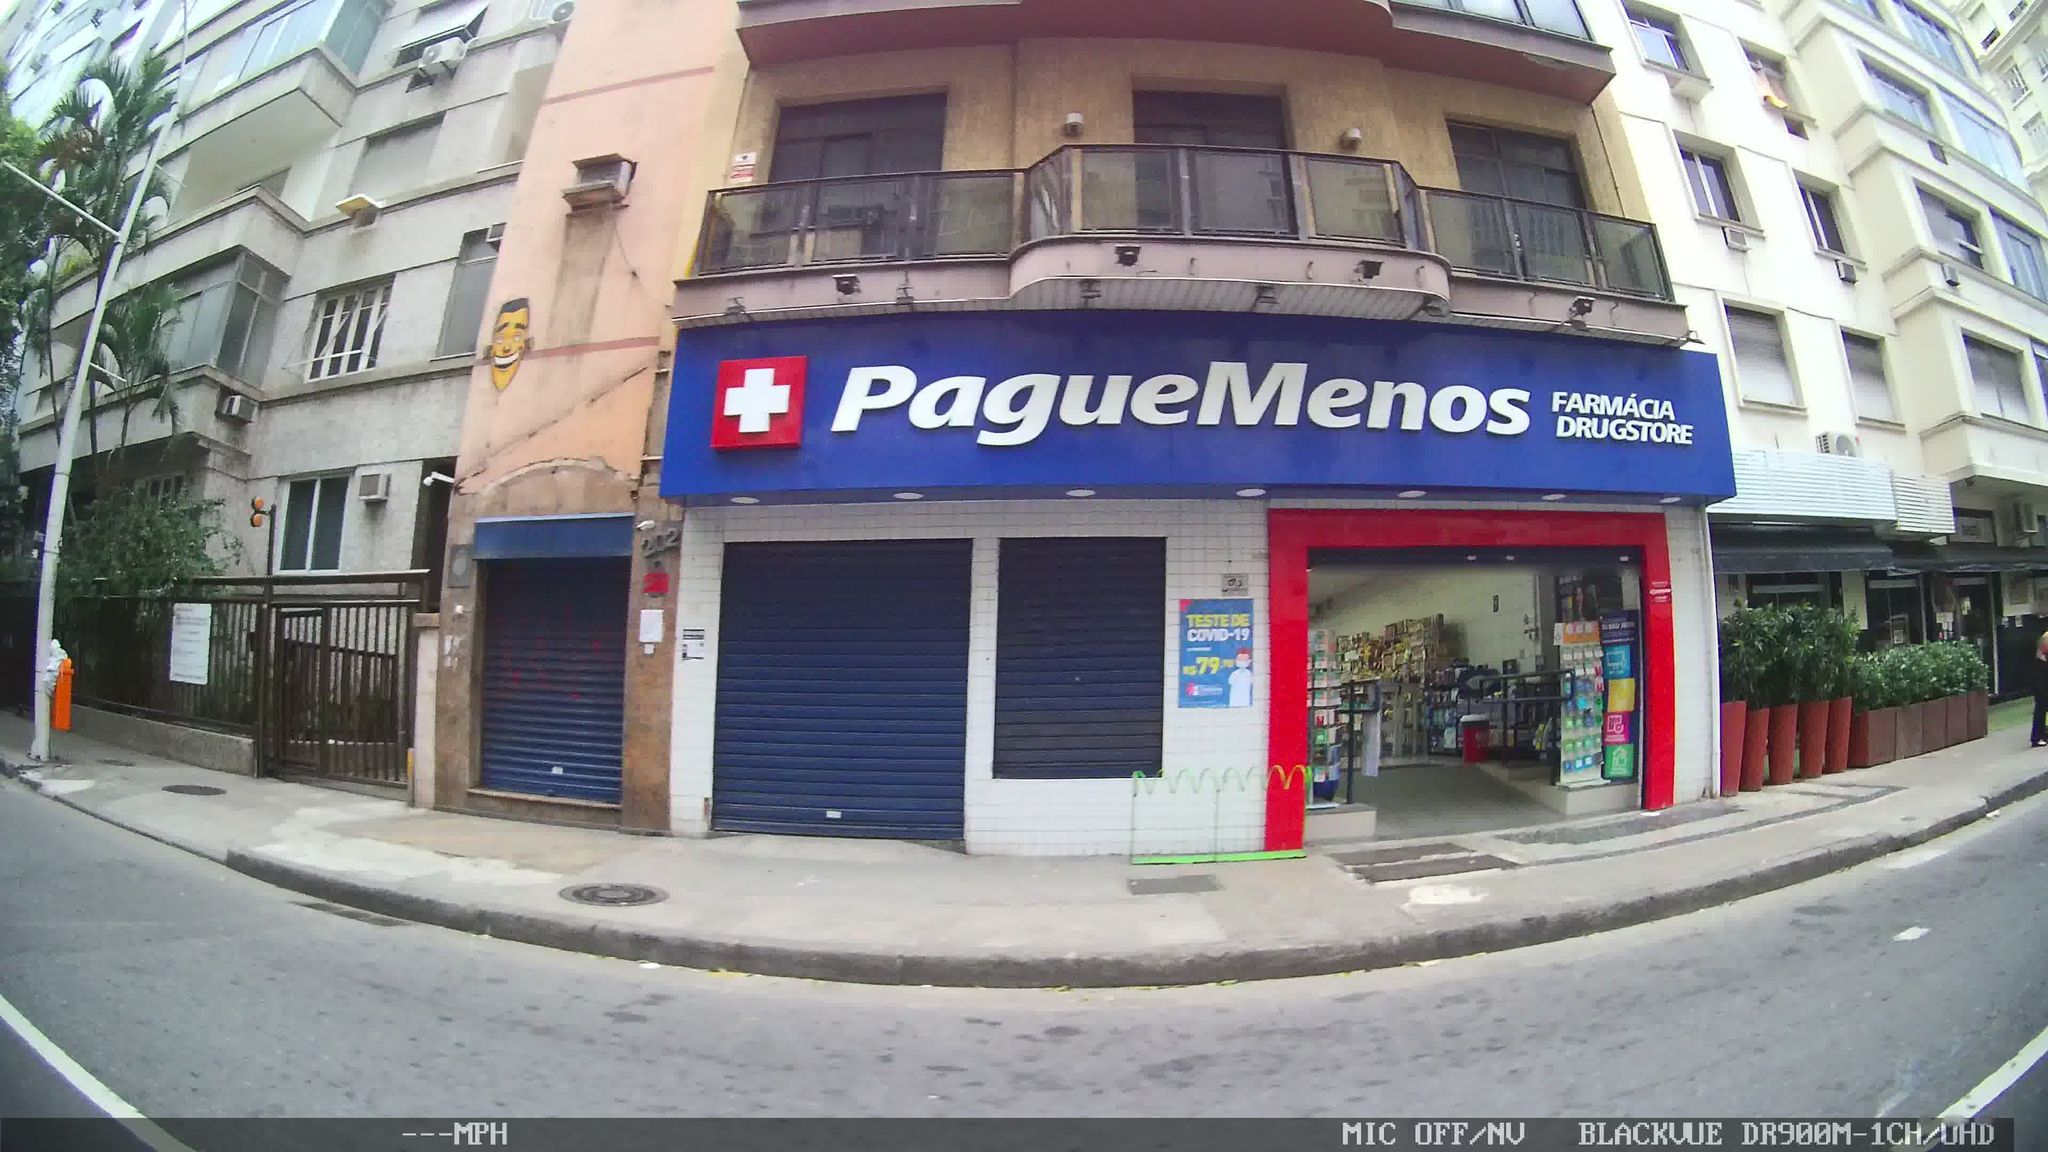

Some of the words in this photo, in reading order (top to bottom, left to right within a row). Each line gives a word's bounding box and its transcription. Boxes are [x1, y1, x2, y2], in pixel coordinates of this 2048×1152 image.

[831, 361, 1531, 446] PagueMenos
[1551, 391, 1676, 421] FARMÁCIA
[1556, 415, 1694, 445] DRUGSTORE
[1186, 614, 1229, 627] TESTE
[1231, 613, 1250, 627] DE
[1187, 628, 1250, 641] COVID-19
